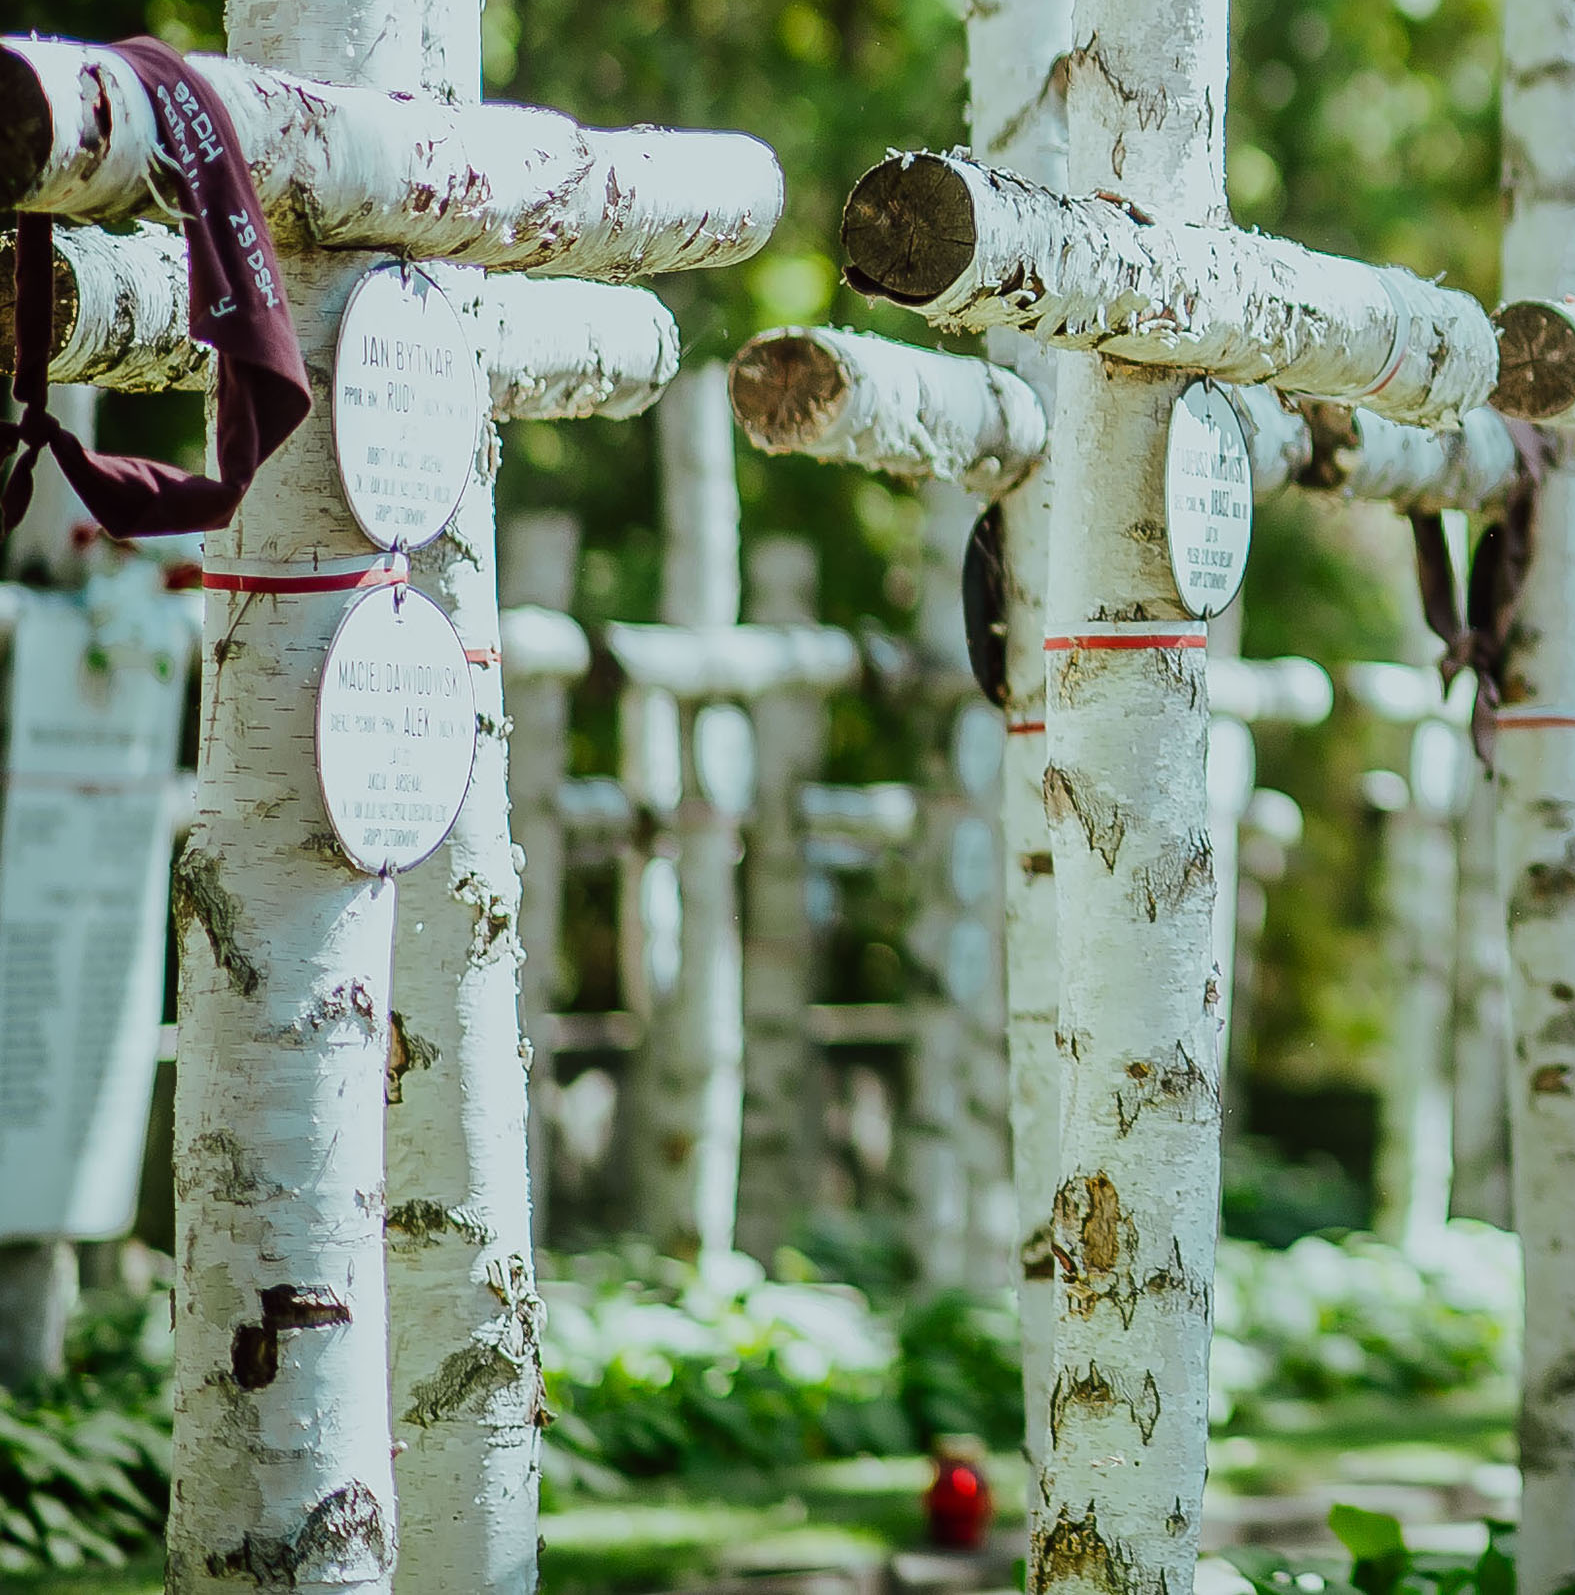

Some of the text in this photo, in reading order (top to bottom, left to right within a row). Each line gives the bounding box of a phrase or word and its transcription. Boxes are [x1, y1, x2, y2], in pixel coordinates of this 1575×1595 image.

[361, 335, 454, 379] JAN BYTNAR
[338, 660, 381, 693] MACIEJ
[403, 707, 431, 738] ALEK
